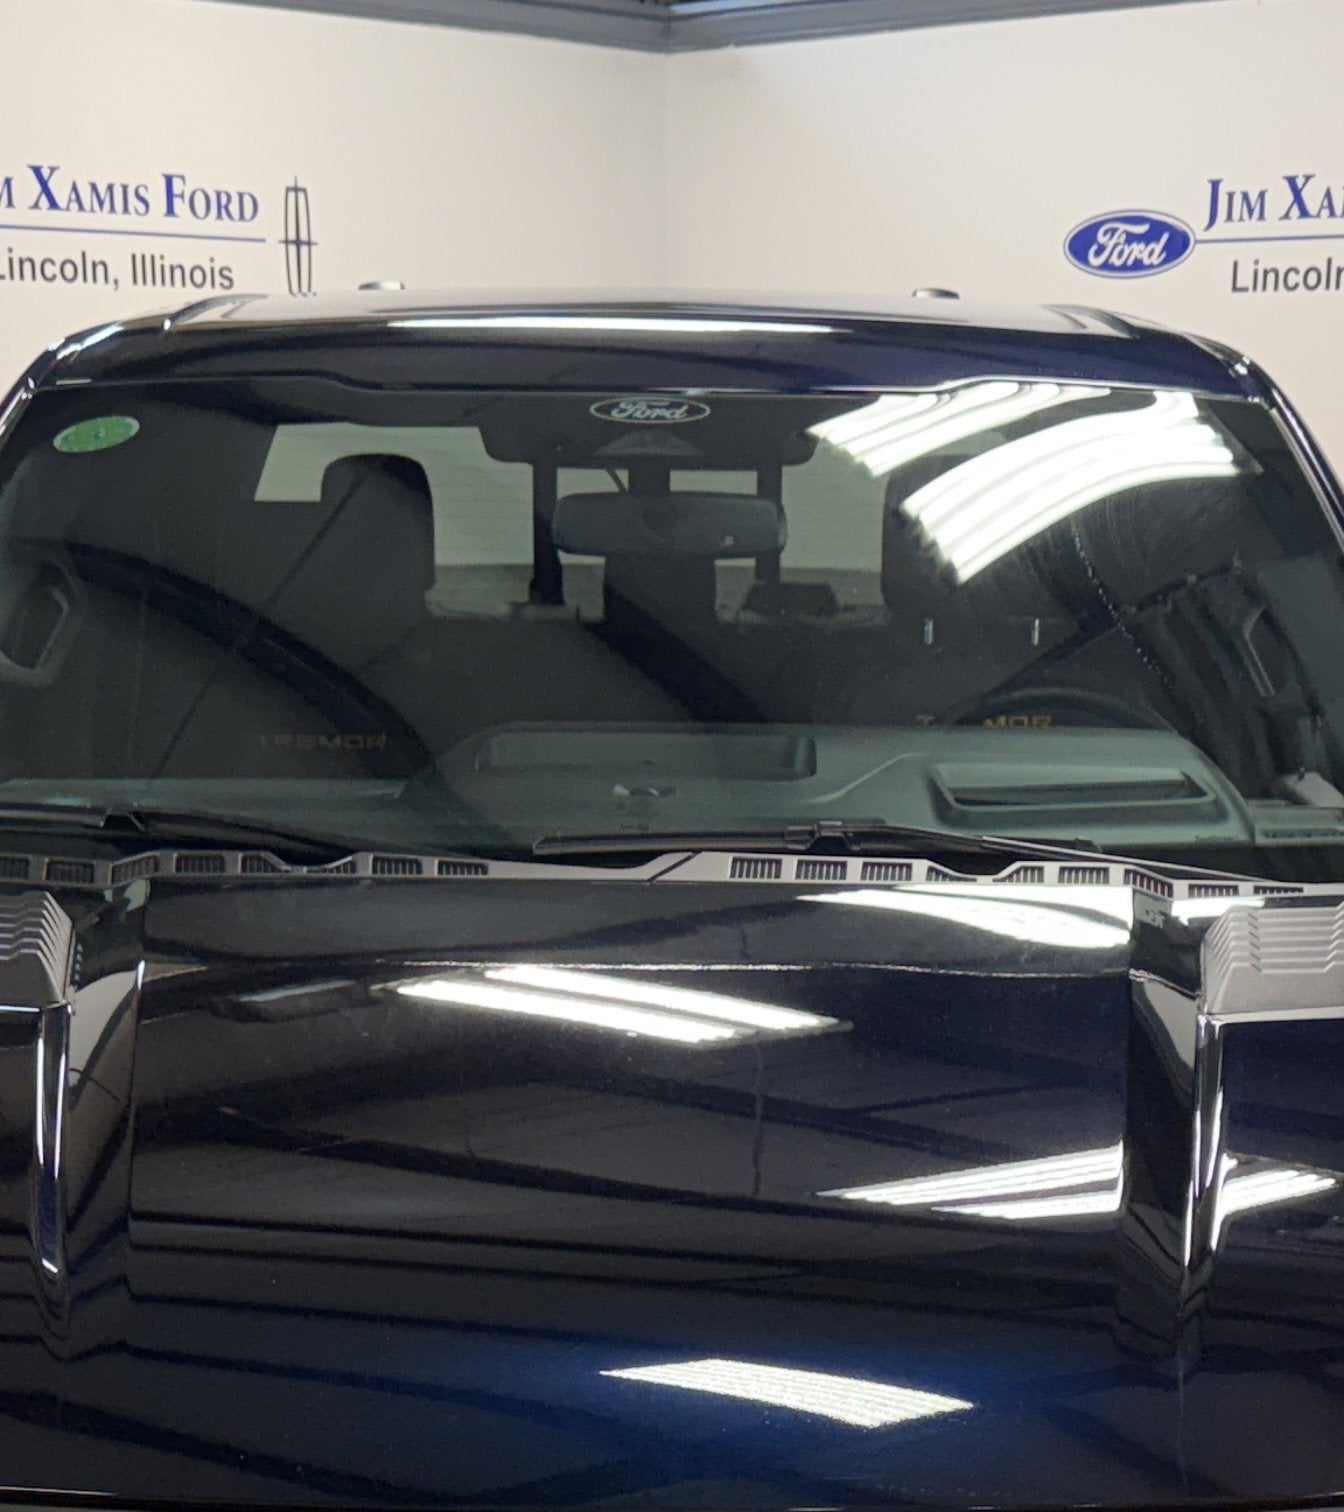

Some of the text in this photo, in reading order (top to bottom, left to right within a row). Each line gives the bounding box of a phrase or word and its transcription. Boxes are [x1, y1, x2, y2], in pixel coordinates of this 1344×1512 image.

[1087, 221, 1170, 268] Ford
[131, 253, 235, 290] Illinois
[611, 400, 690, 420] Ford
